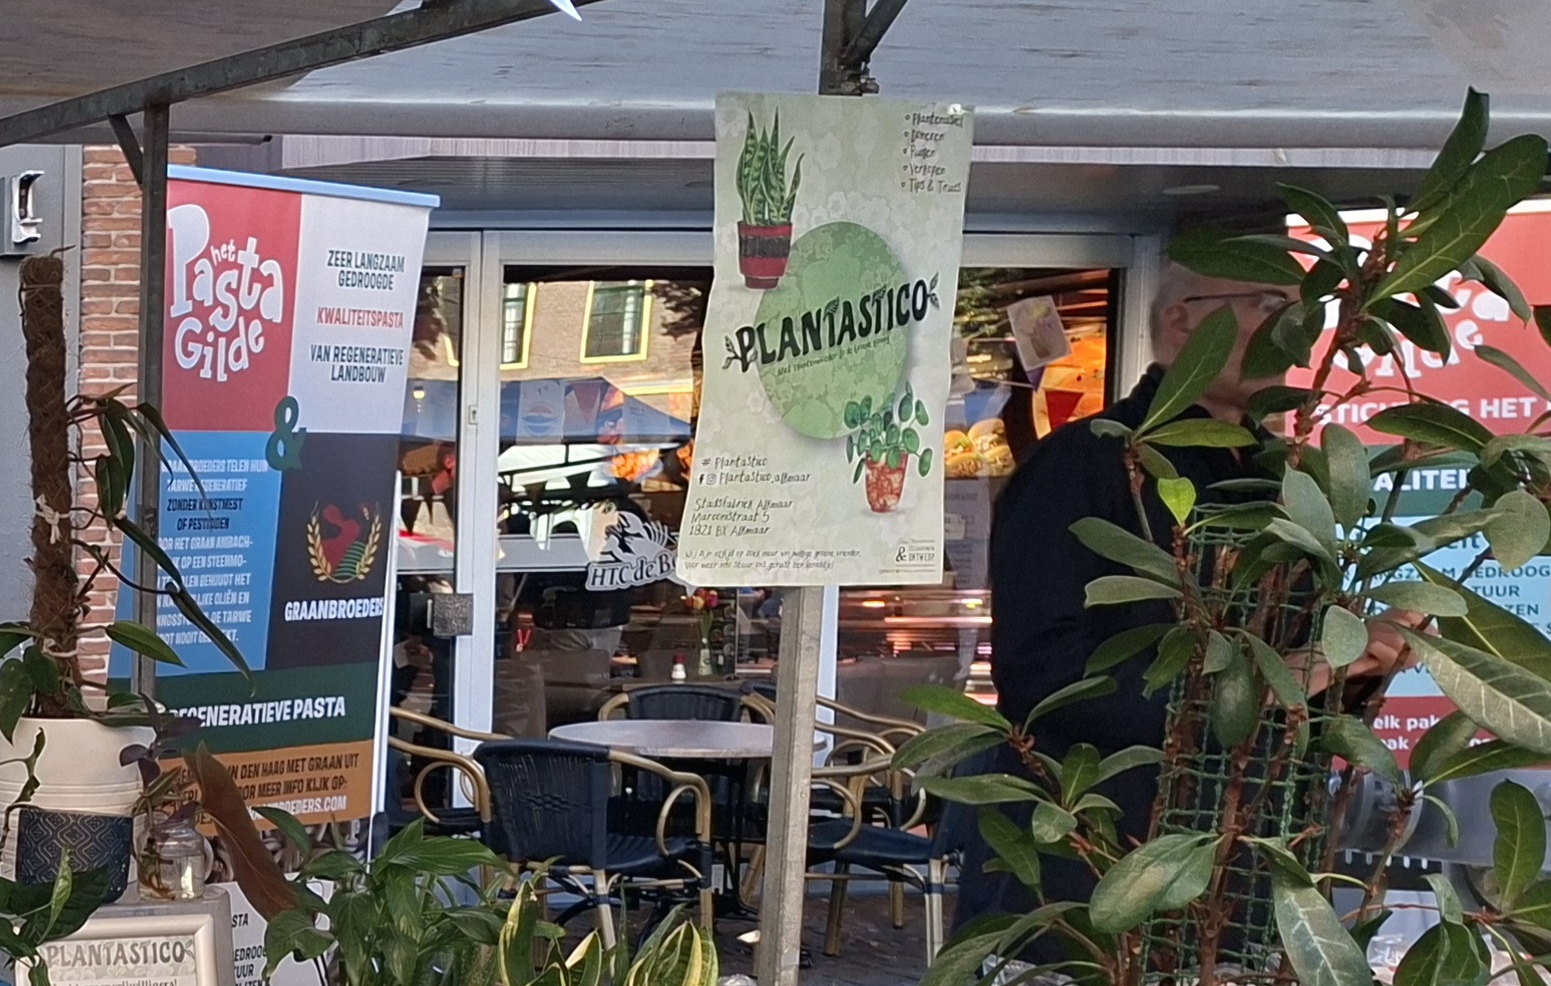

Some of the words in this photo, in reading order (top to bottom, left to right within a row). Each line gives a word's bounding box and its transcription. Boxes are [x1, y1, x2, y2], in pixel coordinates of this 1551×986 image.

[210, 239, 236, 266] het
[327, 249, 353, 268] ZEER
[354, 251, 405, 272] LANGZAAM
[167, 203, 283, 333] Pasta
[338, 270, 394, 290] GEDROOGDE
[316, 306, 404, 329] KWALITEITSPASTA
[735, 278, 928, 373] PLANTASTICO
[175, 315, 264, 382] Gilde
[310, 344, 332, 363] VAN
[333, 346, 404, 365] REGENERATIEVE
[331, 364, 386, 383] LANDBOUW
[1480, 398, 1537, 418] HET
[762, 510, 770, 523] 5
[689, 524, 712, 536] 1821
[590, 564, 630, 587] HTC
[633, 555, 655, 582] de
[293, 697, 345, 719] PASTA
[261, 760, 285, 777] HAAG
[286, 757, 306, 774] MET
[307, 755, 342, 772] GRAAN
[47, 940, 186, 969] PLANTASTICO
